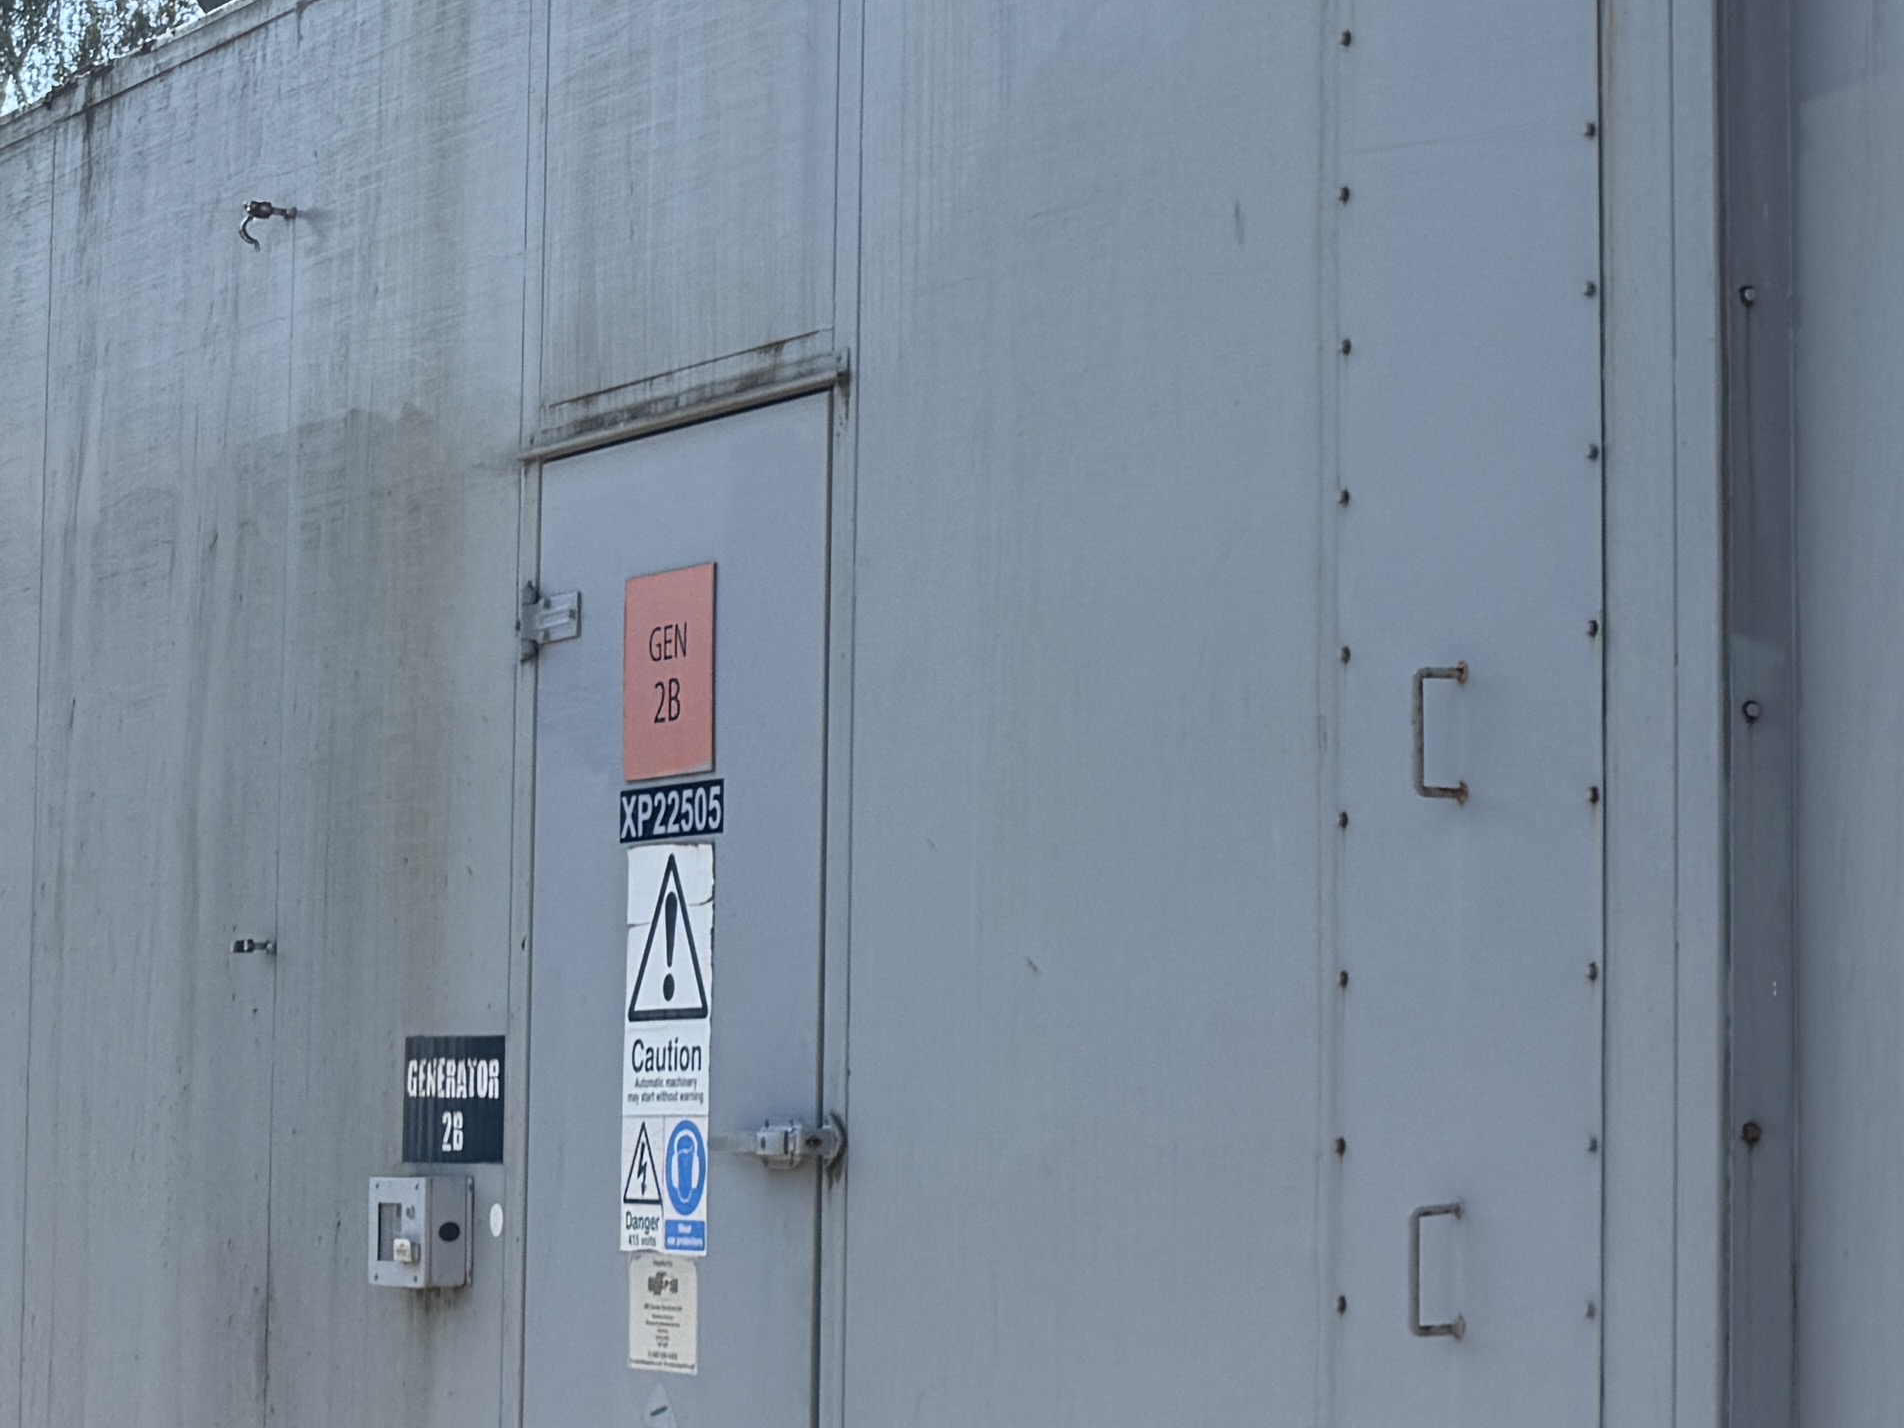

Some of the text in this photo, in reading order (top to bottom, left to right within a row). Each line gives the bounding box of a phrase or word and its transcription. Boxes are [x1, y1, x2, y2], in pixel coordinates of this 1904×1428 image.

[649, 621, 688, 662] GEN
[654, 678, 681, 724] 2B
[620, 785, 722, 840] XP22505
[631, 1036, 702, 1073] Caution
[407, 1057, 500, 1100] GENERATOR
[441, 1110, 464, 1152] 2B
[625, 1211, 660, 1235] Danger
